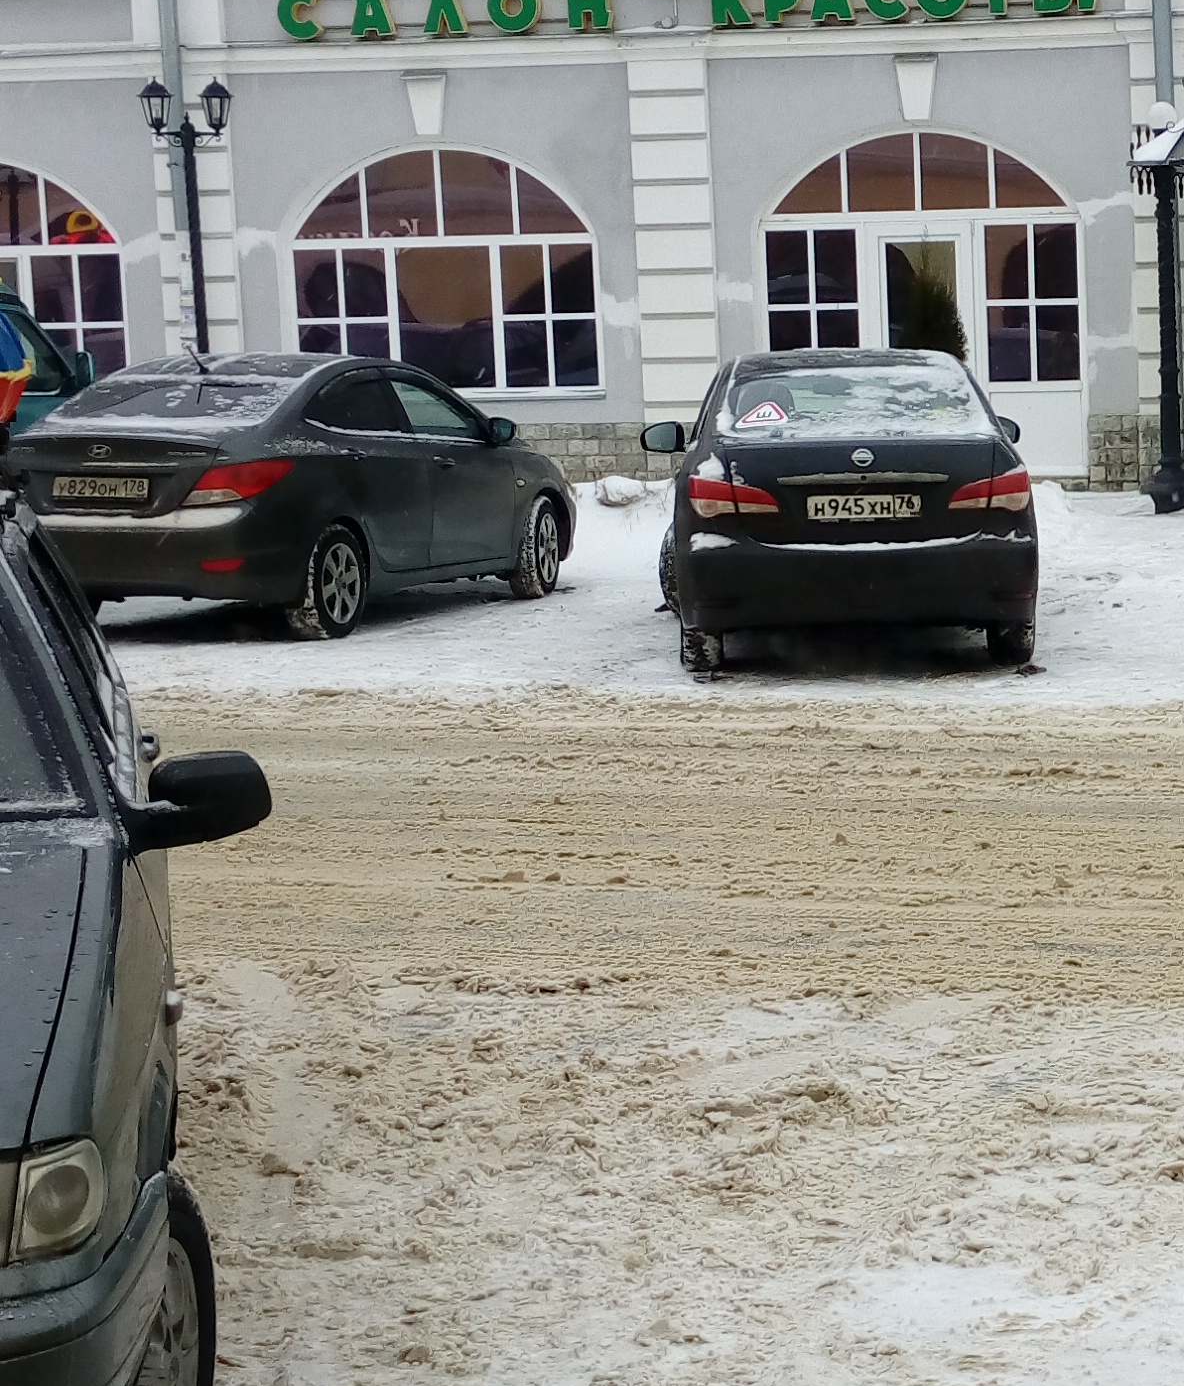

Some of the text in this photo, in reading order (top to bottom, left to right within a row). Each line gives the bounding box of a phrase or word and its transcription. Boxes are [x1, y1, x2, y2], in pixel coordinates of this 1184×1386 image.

[122, 479, 146, 493] 178
[814, 496, 915, 516] Н945ХН 76
